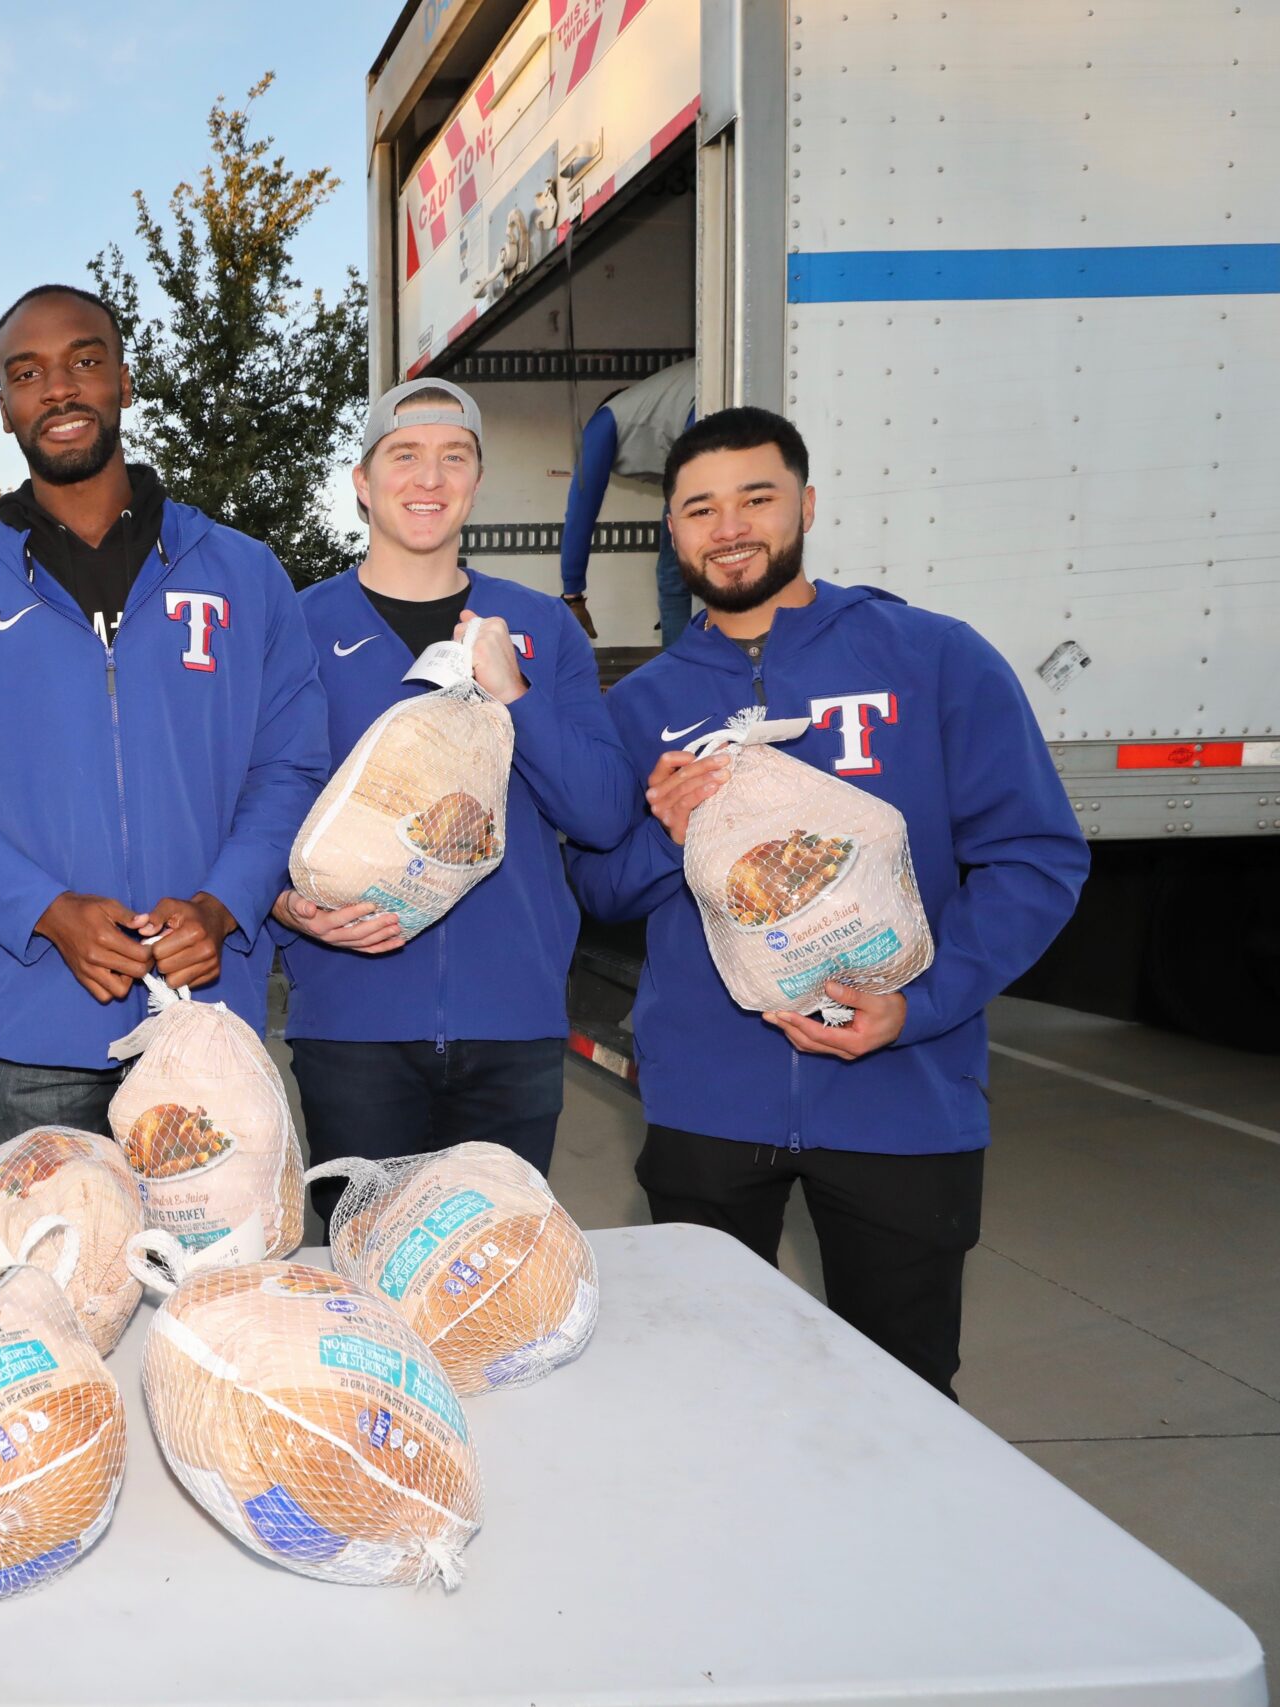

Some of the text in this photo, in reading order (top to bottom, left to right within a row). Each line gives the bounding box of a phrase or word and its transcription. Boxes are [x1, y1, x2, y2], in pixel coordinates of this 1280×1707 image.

[558, 3, 580, 41] THIS
[564, 8, 590, 52] WIDE
[419, 126, 492, 230] CAUTION:
[161, 588, 231, 674] T
[809, 690, 900, 777] T
[781, 917, 865, 963] YOUNG TURKEY
[167, 1207, 206, 1222] TURKEY
[322, 1338, 340, 1351] NO
[336, 1352, 348, 1365] OR
[340, 1377, 349, 1388] 21
[350, 1379, 376, 1394] GRAMS
[384, 1391, 410, 1415] PROTEIN
